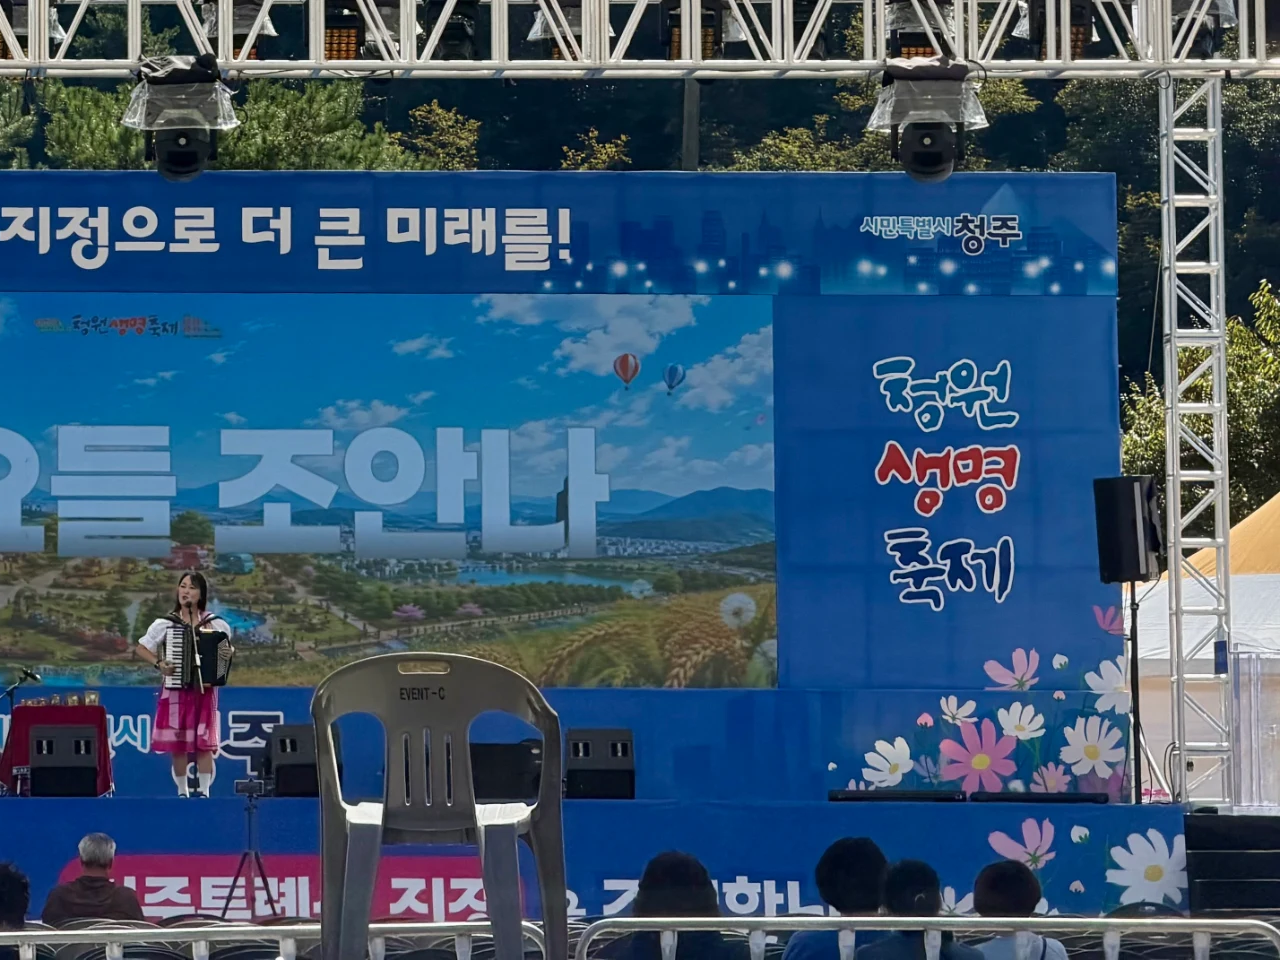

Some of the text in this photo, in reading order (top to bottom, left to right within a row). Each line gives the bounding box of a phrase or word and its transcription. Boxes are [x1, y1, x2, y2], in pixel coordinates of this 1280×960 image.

[0, 206, 220, 270] 지정으로
[241, 206, 292, 255] 더
[314, 207, 366, 270] 큰
[386, 207, 571, 271] 미래를!
[953, 213, 1023, 256] 청주
[872, 355, 1020, 432] 청원
[214, 426, 611, 559] 조안나
[874, 440, 1021, 518] 생명
[883, 527, 1015, 612] 축제
[399, 686, 446, 701] EVENT-C
